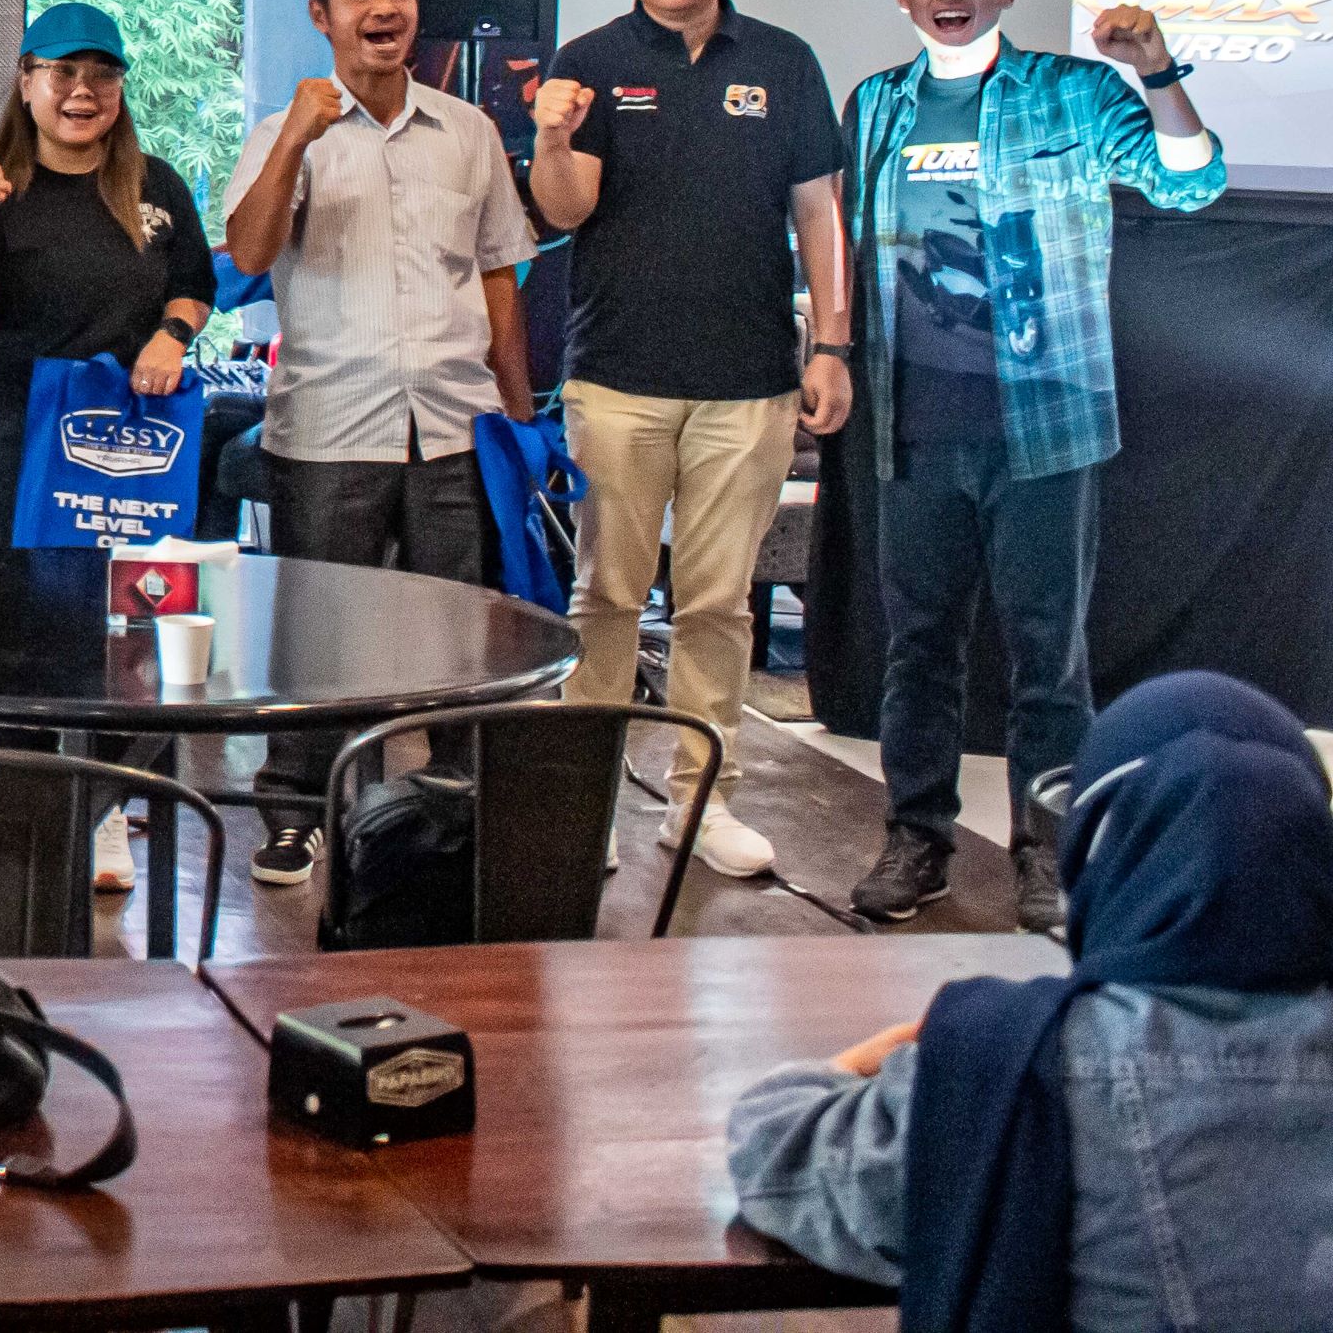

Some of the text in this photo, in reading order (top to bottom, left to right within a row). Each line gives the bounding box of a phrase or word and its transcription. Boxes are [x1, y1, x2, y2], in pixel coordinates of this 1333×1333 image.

[53, 491, 179, 519] THE NEXT
[75, 513, 152, 537] LEVEL
